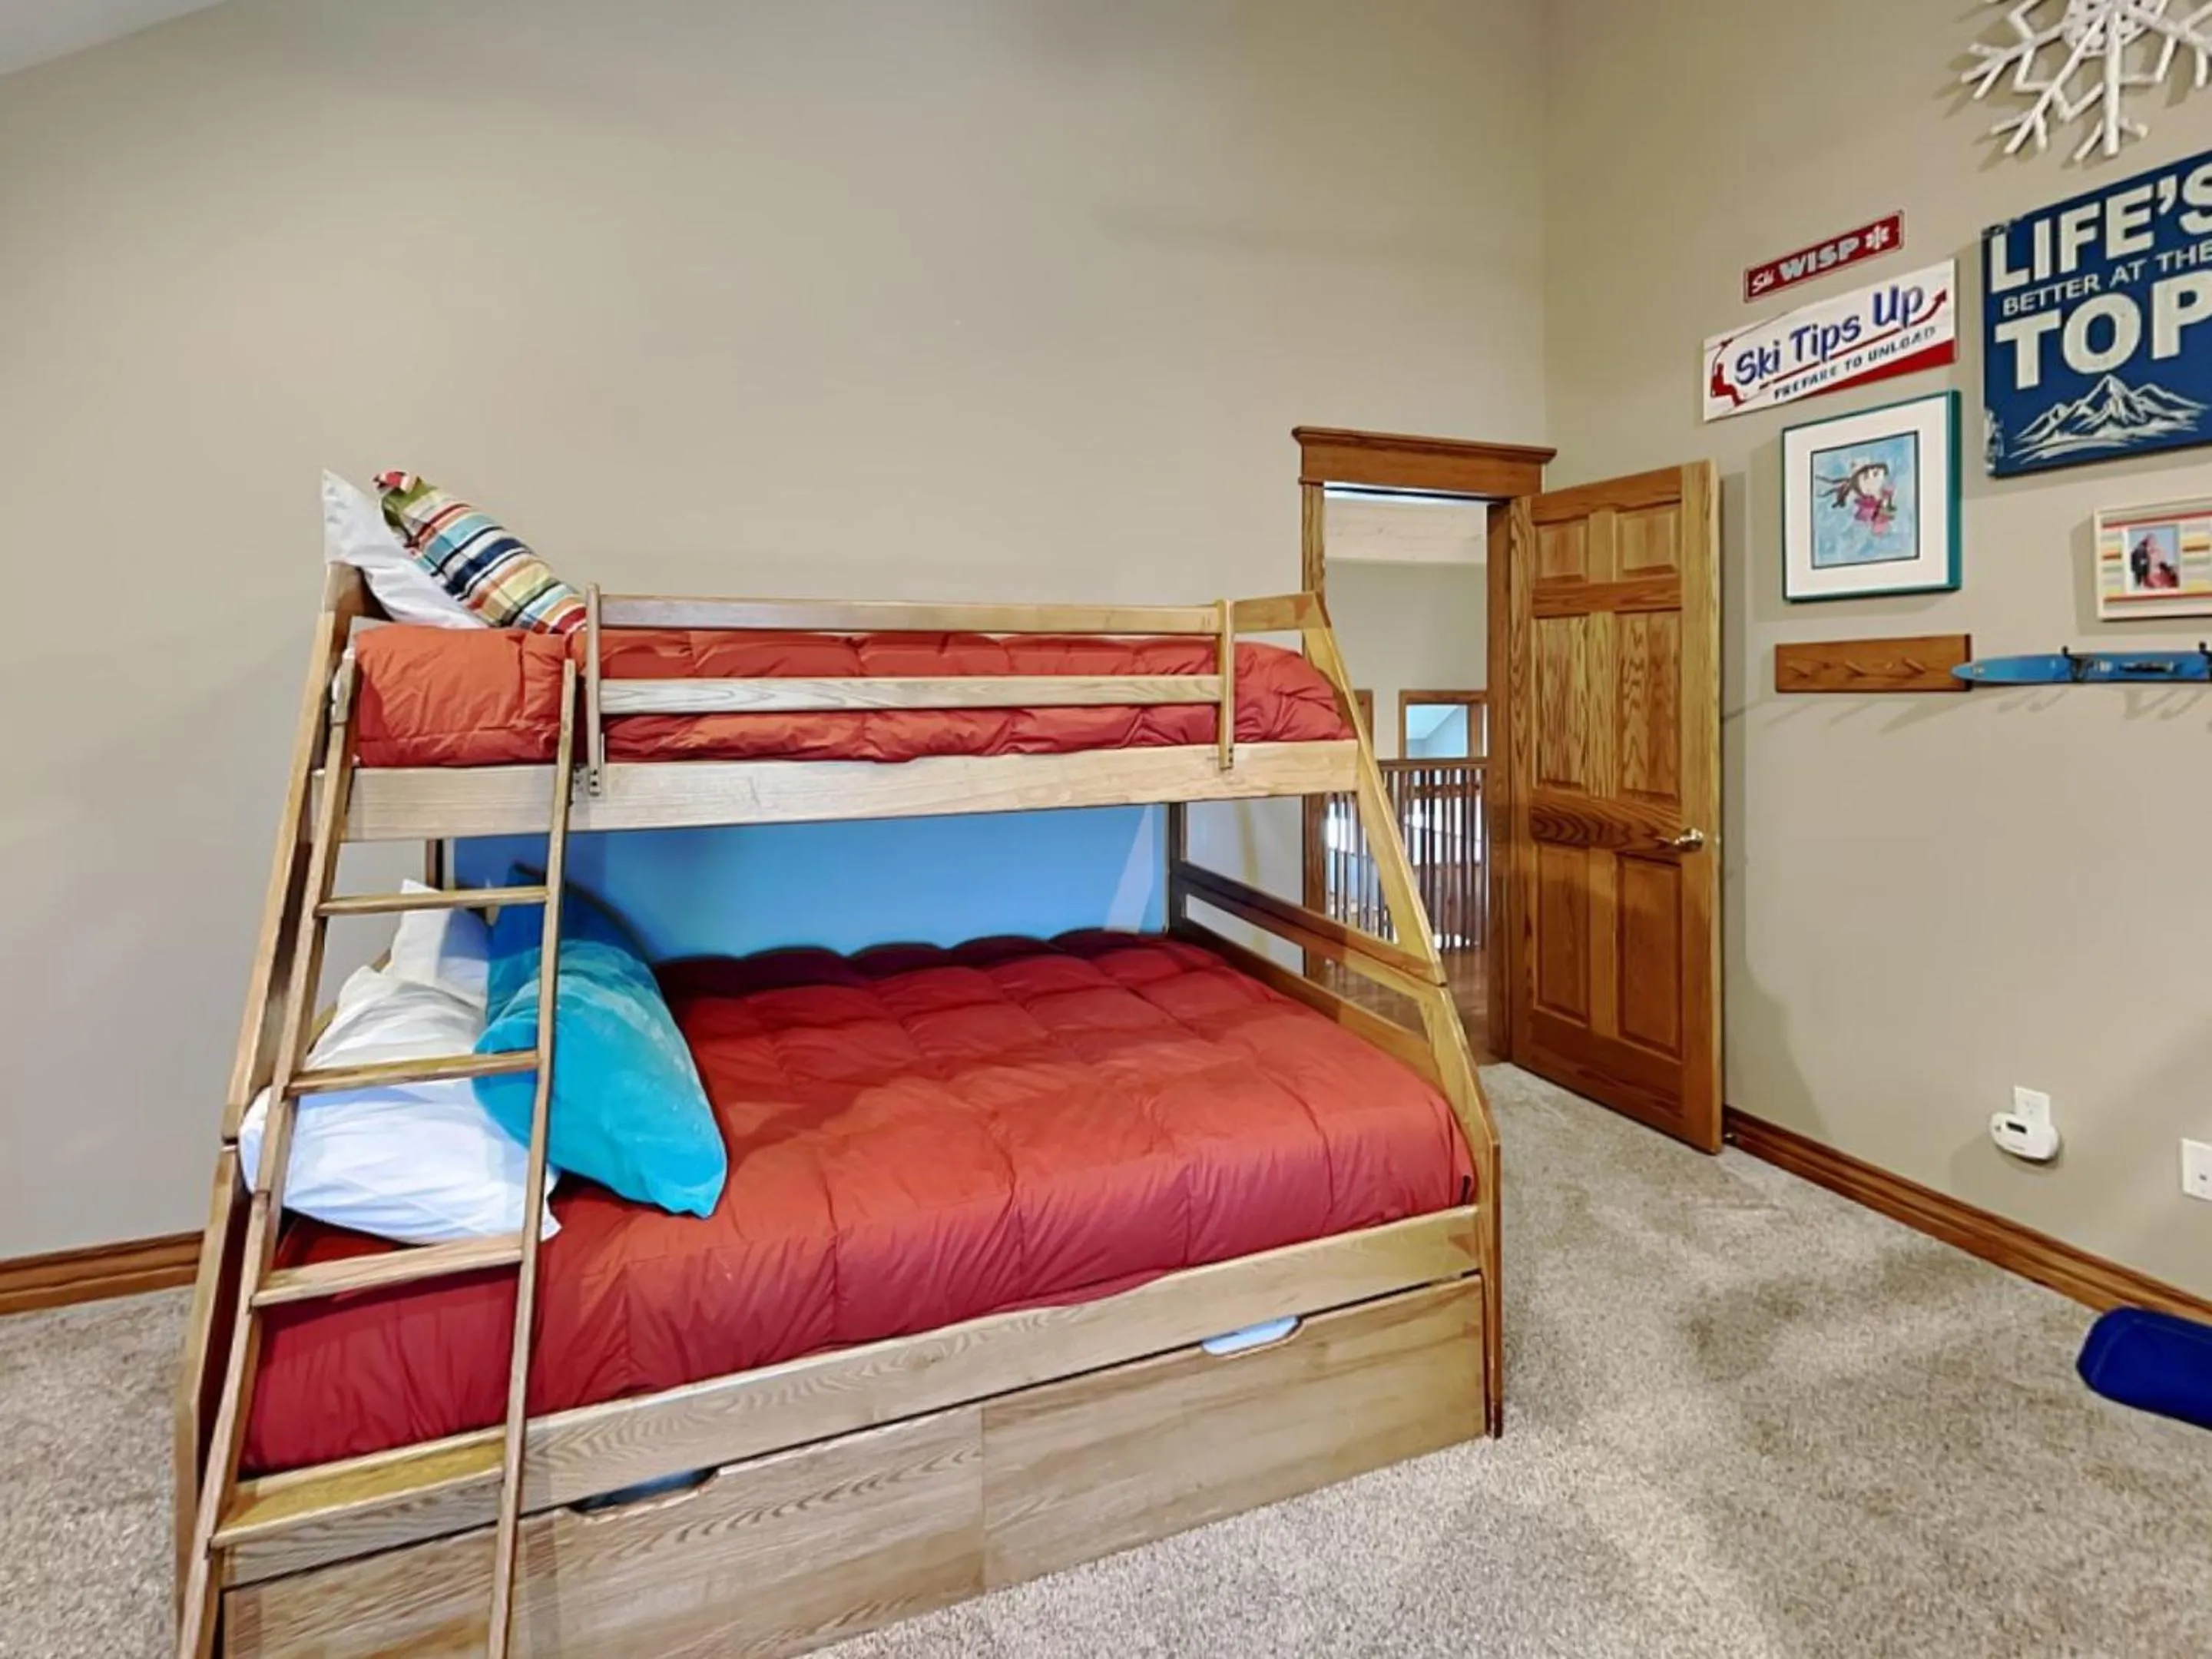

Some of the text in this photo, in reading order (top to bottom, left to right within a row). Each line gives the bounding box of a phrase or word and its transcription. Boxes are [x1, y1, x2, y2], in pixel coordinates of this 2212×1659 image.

[1779, 237, 1859, 281] WISP
[2002, 241, 2212, 316] BETTER AT THE
[1734, 285, 1924, 386] Ski Tips Up
[1773, 325, 1936, 400] PREPARE TO UNLOAD
[1995, 268, 2212, 390] TOP
